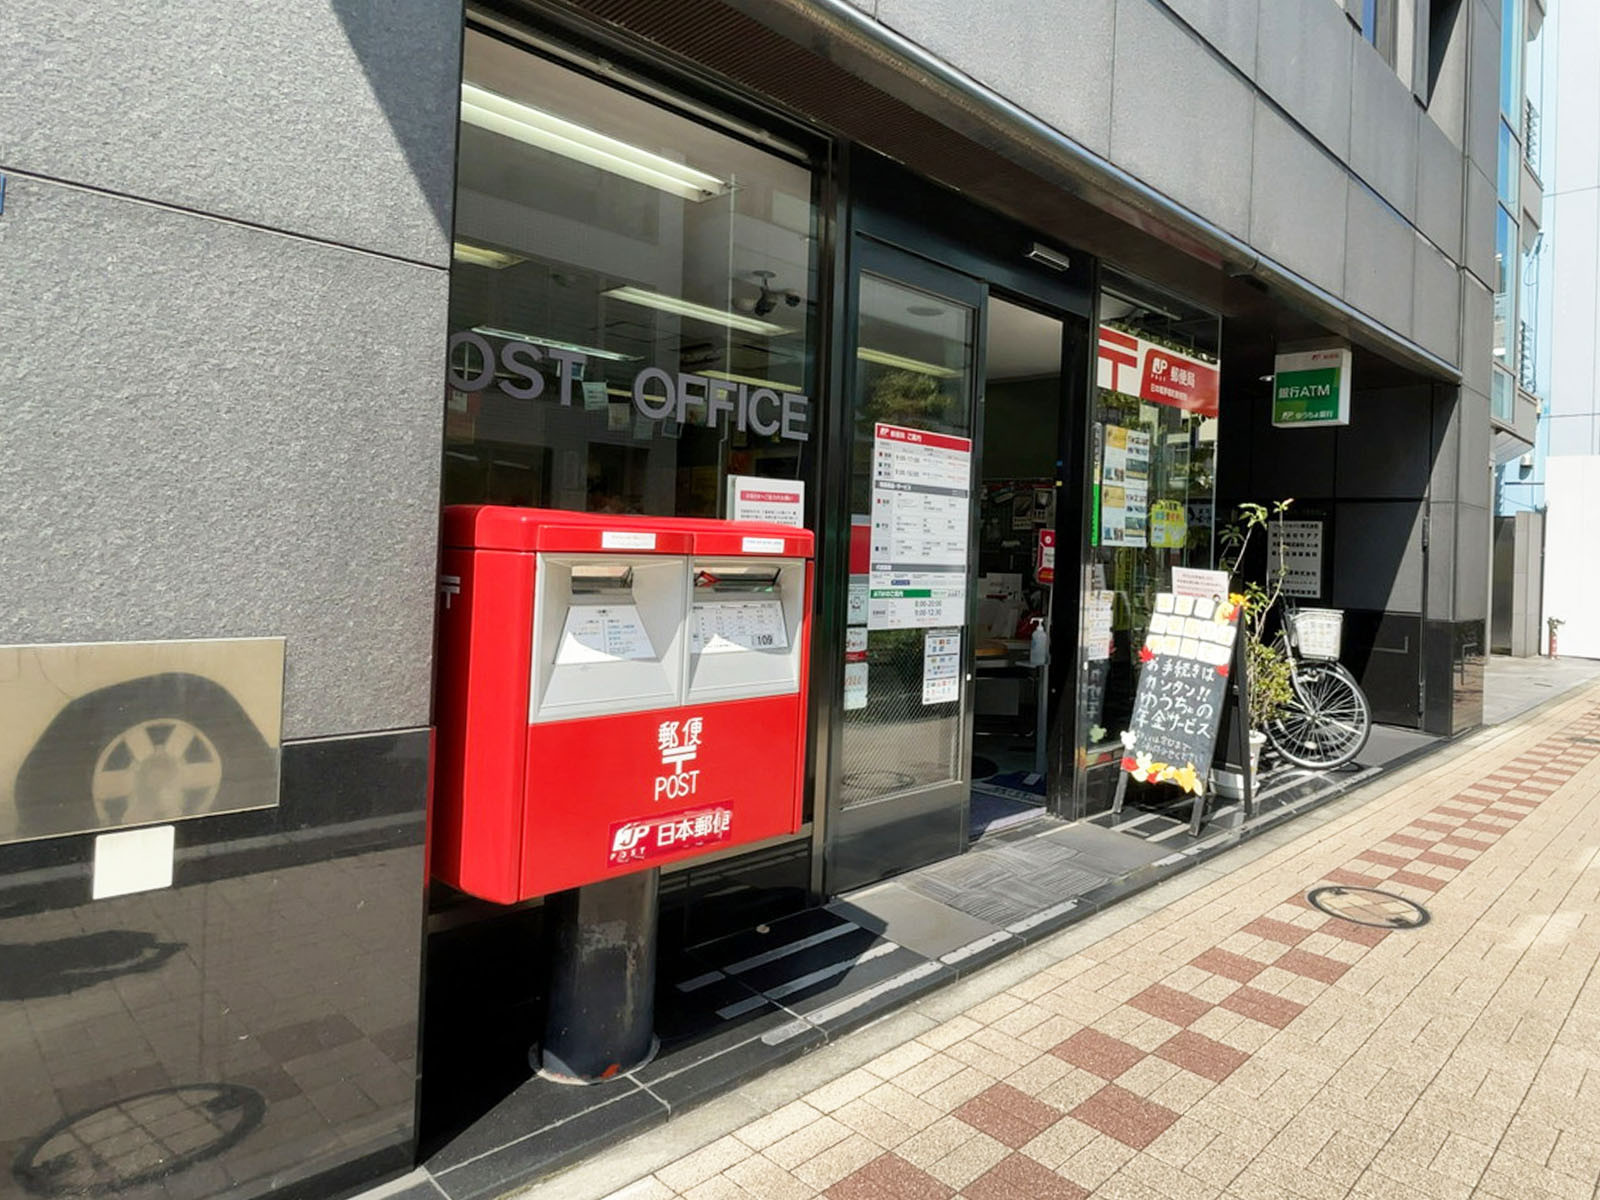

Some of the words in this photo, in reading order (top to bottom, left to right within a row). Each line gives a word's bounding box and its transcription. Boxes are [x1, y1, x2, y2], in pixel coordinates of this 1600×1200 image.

[632, 367, 809, 441] OFFICE
[1278, 384, 1331, 399] 銀行ATM
[757, 634, 773, 646] 109
[1146, 657, 1215, 682] お手続きは
[1140, 691, 1214, 719] ゆうちょの
[658, 717, 703, 750] 郵便
[1135, 708, 1212, 739] 年金サービス
[654, 770, 700, 801] POST
[657, 811, 732, 846] 日本郵便
